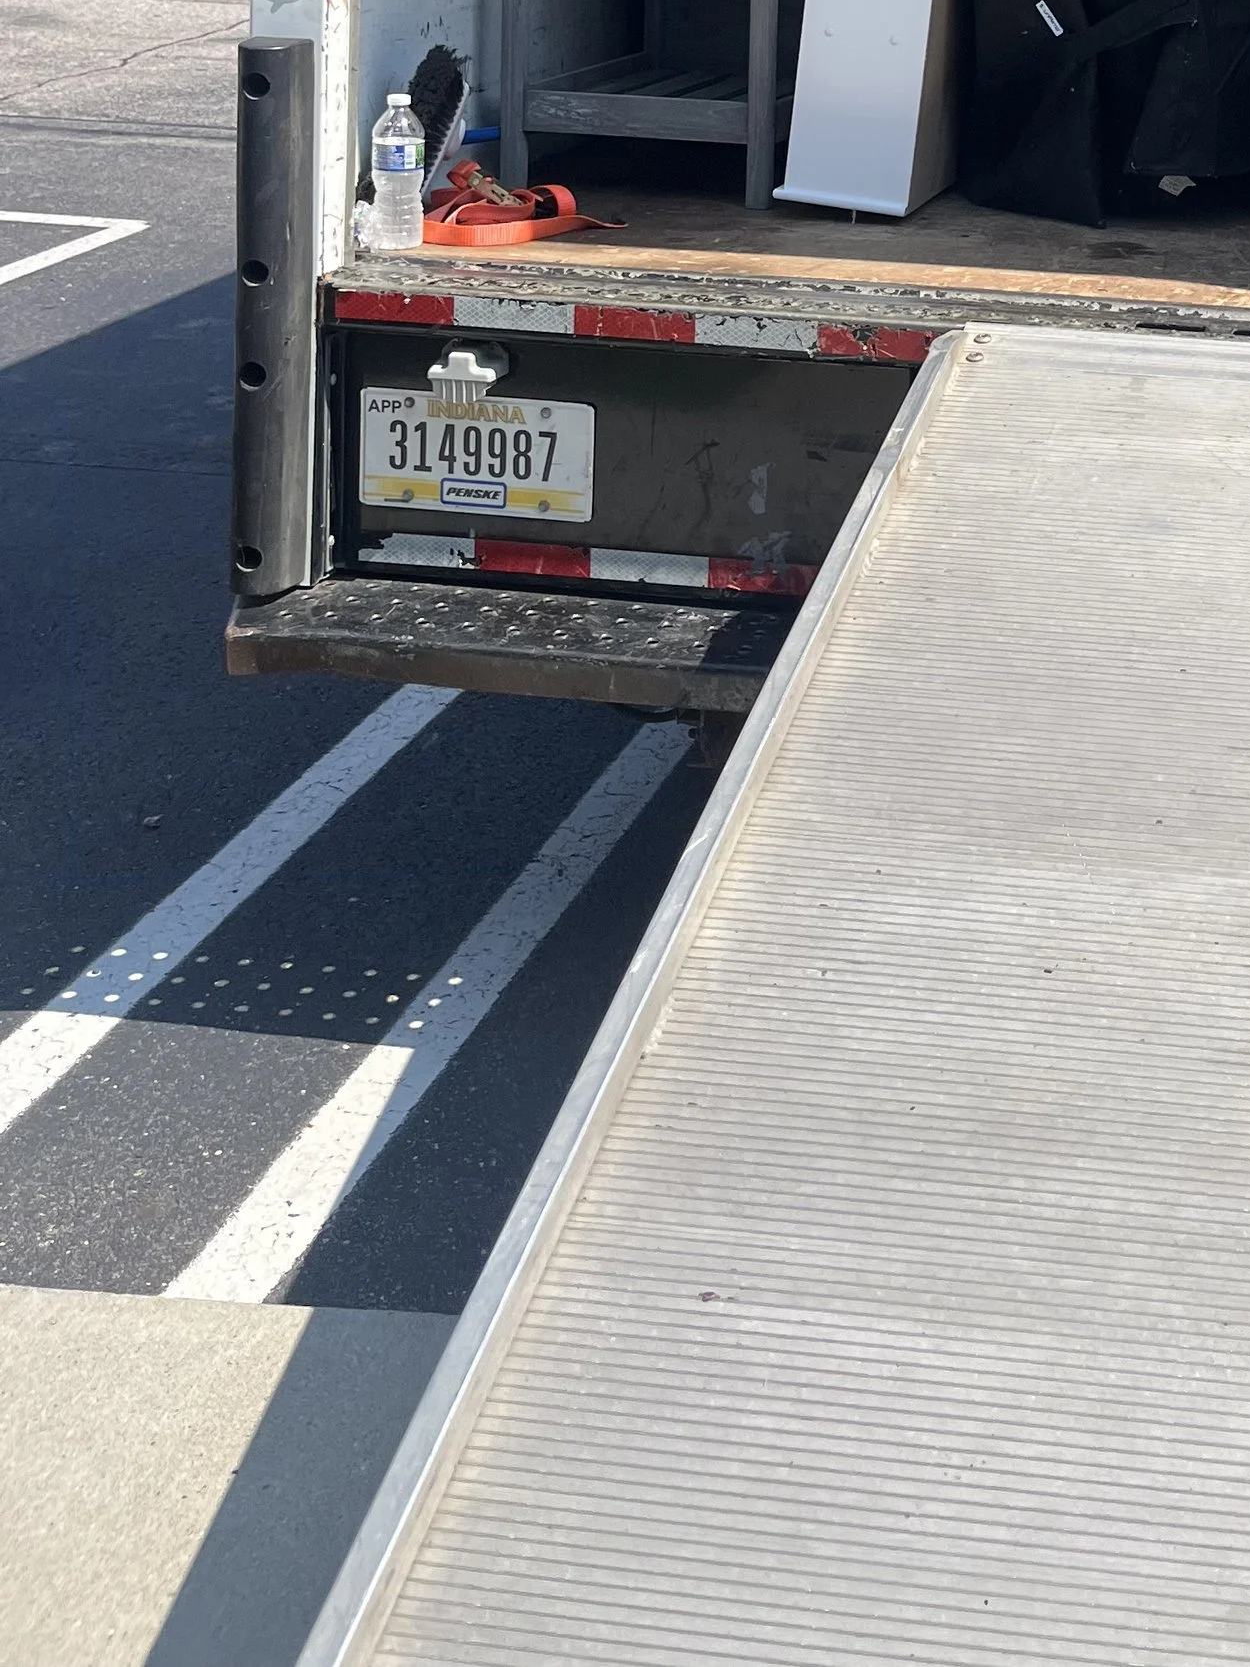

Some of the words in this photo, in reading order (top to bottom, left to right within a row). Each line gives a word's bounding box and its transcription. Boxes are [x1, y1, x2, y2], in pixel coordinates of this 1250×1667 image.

[367, 399, 402, 413] APP
[426, 399, 527, 425] INDIANA
[388, 419, 558, 483] 3149987
[445, 486, 503, 501] PENSKE
